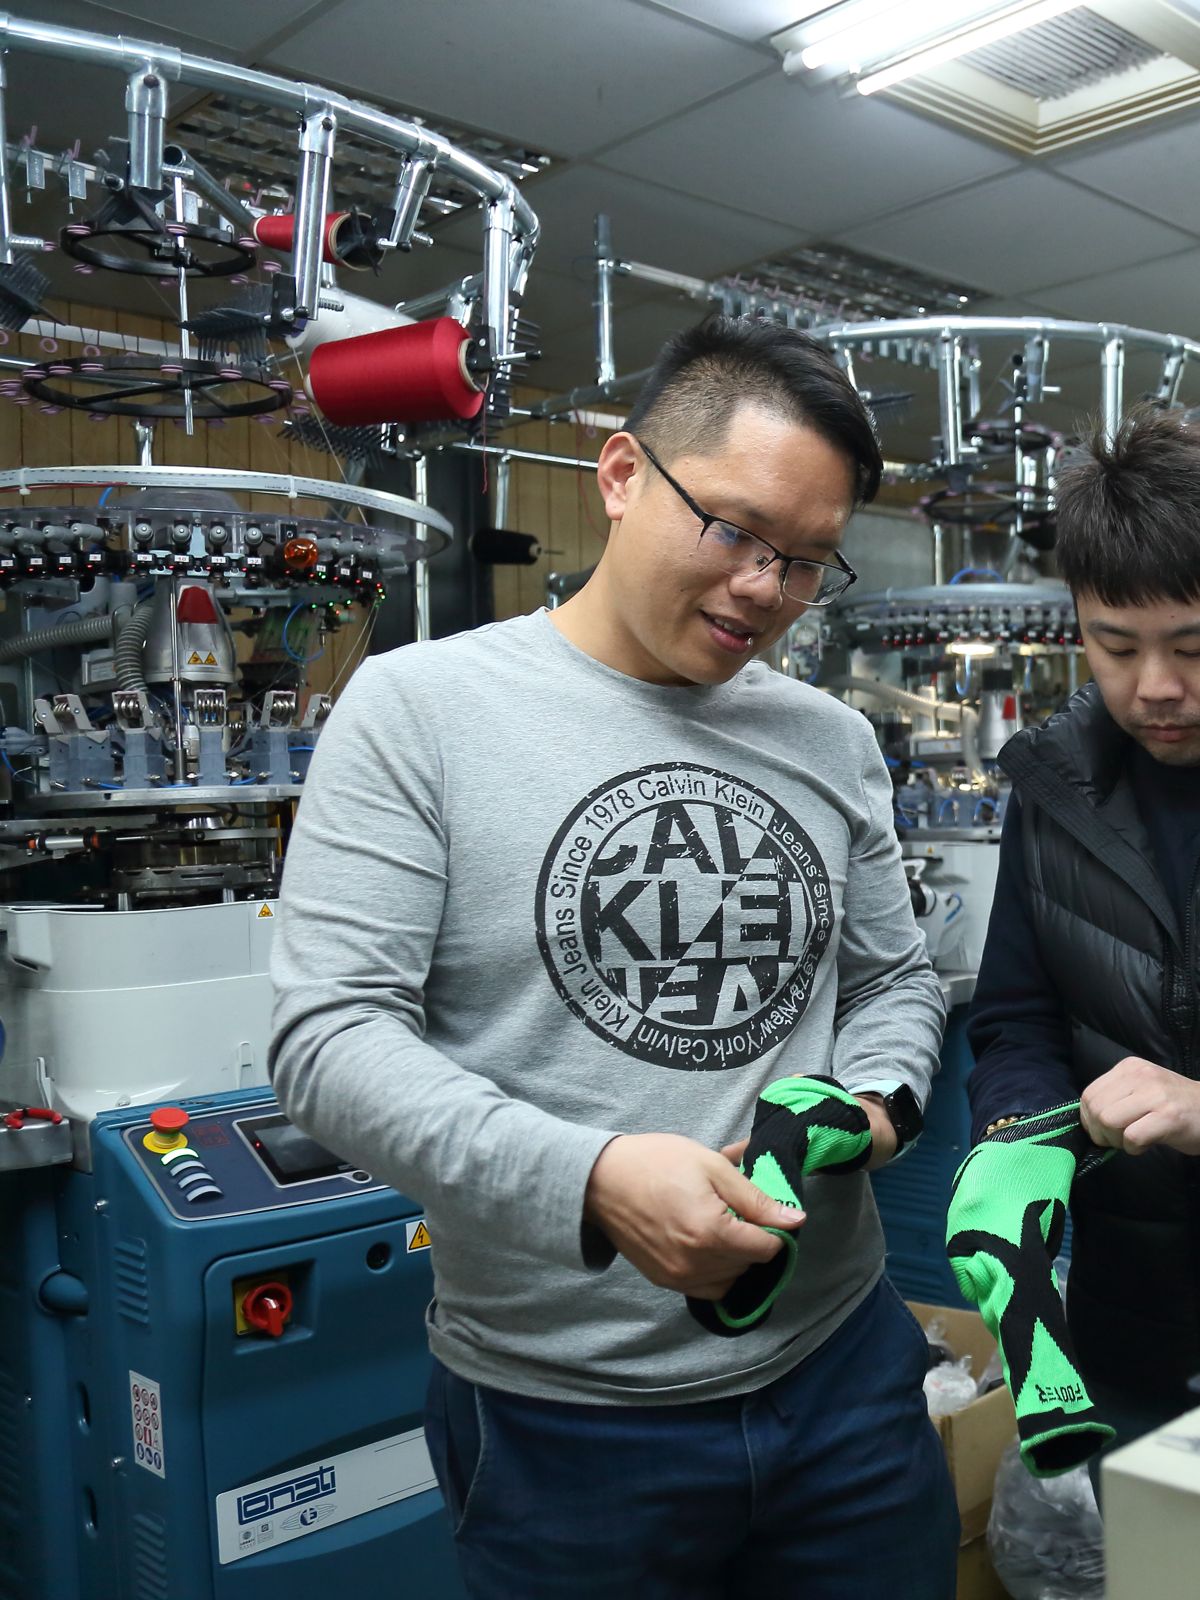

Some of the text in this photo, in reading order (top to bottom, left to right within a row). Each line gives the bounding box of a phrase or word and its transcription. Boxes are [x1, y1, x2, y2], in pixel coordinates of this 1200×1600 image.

[584, 788, 636, 831] 1978
[637, 774, 706, 801] Calvin
[714, 780, 765, 820] Klein
[550, 836, 593, 899] Since
[772, 822, 817, 878] Jeans
[813, 882, 830, 941] Since
[555, 907, 588, 976] Jeans
[580, 978, 630, 1033] Klein
[637, 1024, 708, 1063] Calvin
[712, 1031, 760, 1062] York
